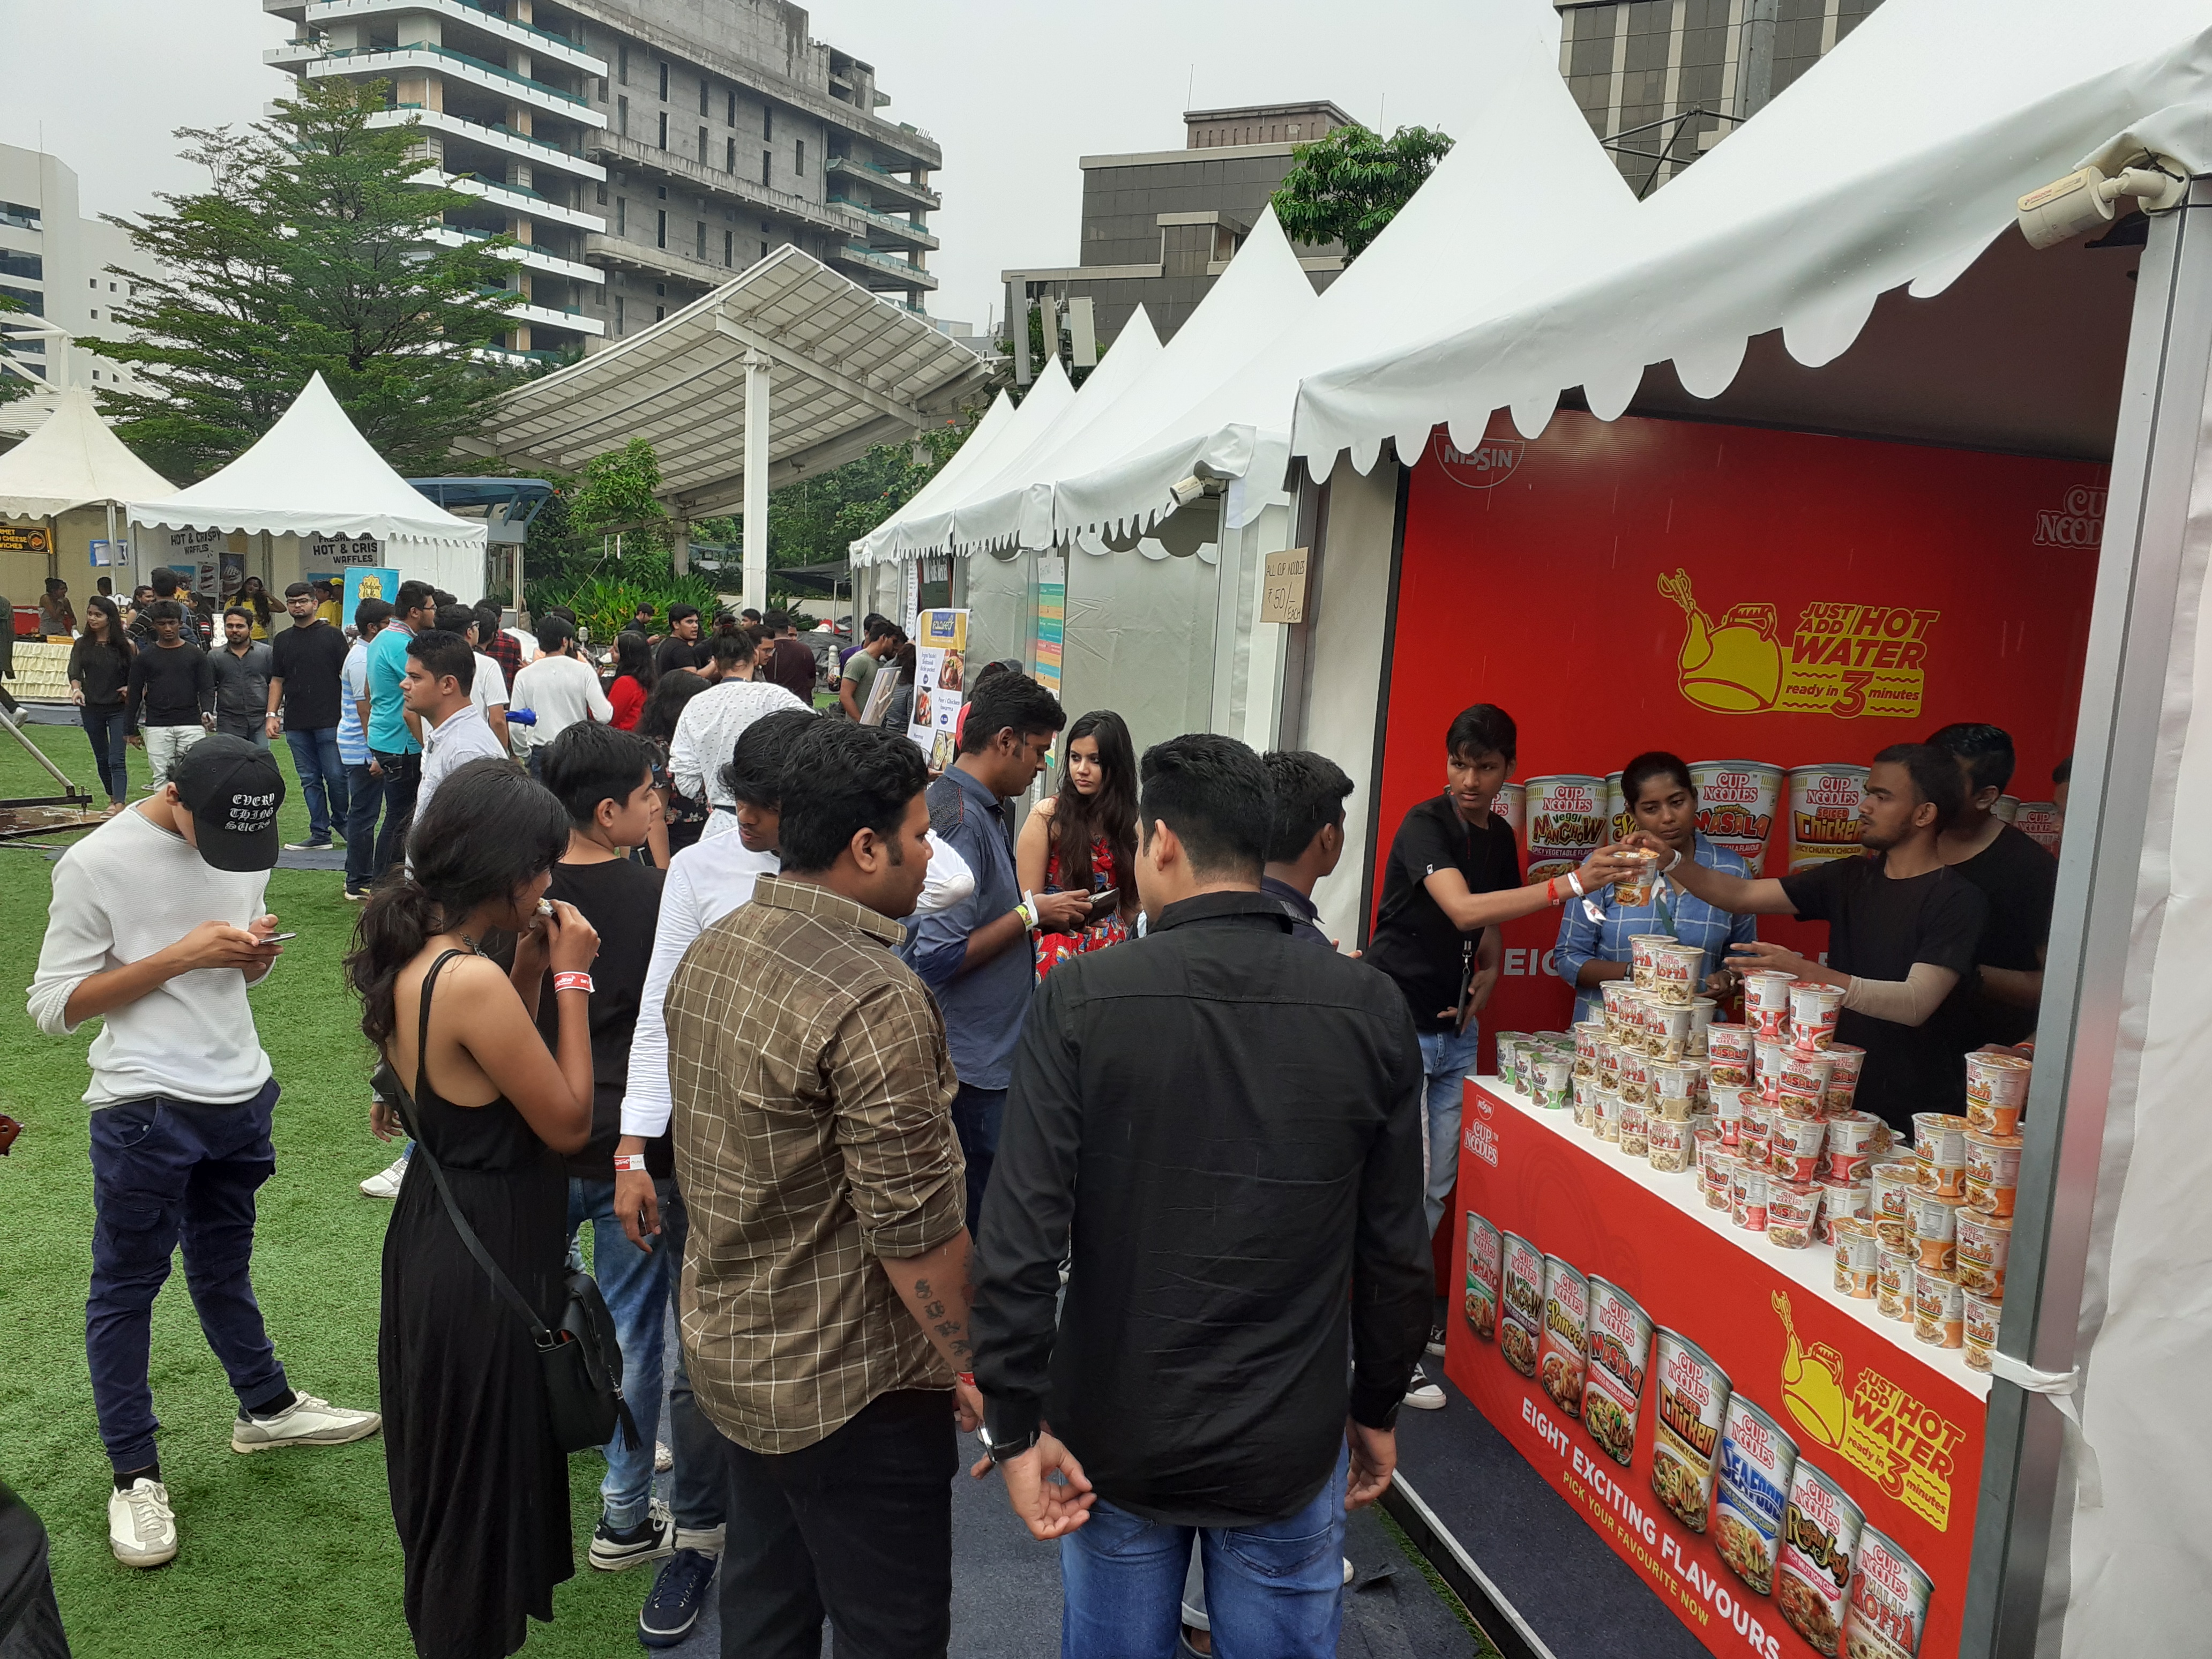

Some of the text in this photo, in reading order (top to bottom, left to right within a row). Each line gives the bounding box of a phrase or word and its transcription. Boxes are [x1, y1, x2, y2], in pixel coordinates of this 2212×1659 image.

[171, 530, 221, 545] HOT & CRISPY
[184, 544, 209, 555] WAFFLES
[313, 544, 335, 556] HOT
[340, 543, 348, 554] &
[333, 555, 373, 563] WAFFLES
[1266, 565, 1275, 577] ALL
[1287, 606, 1301, 621] EACH
[1796, 618, 1844, 634] ADD
[1801, 603, 1939, 640] JUST HOT
[1791, 634, 1926, 670] WATER
[1785, 670, 1920, 718] ready in 3 minutes
[1555, 786, 1585, 799] CUP
[1703, 786, 1758, 802] NOODLES
[1717, 773, 1750, 788] CUP
[1819, 776, 1851, 792] CUP
[233, 793, 274, 807] EVERY
[1543, 798, 1593, 812] NOODLES
[1806, 790, 1859, 805] NOODLES
[225, 819, 271, 832] SUCKS
[229, 807, 274, 821] THING
[1694, 809, 1771, 840] MASALA
[1817, 807, 1849, 819] SPICED
[2027, 812, 2049, 823] CUP
[1532, 846, 1577, 856] SPICY VEGETABLE
[1809, 846, 1836, 854] CHUNKY
[1780, 1071, 1821, 1091] MASALA
[1474, 1120, 1493, 1143] CUP
[1465, 1130, 1497, 1165] NOODLES
[1769, 1202, 1811, 1222] MASALA
[1474, 1232, 1496, 1259] NOODLES
[1479, 1226, 1492, 1243] CUP
[1468, 1251, 1499, 1292] TOMATO
[1511, 1254, 1538, 1286] NOODLES
[1518, 1248, 1534, 1268] CUP
[1554, 1281, 1583, 1316] NOODLES
[1561, 1273, 1579, 1296] CUP
[1609, 1297, 1630, 1325] CUP
[1546, 1298, 1588, 1355] Paneer
[1600, 1305, 1635, 1347] NOODLES
[1589, 1332, 1643, 1399] MASALA
[1678, 1352, 1703, 1381] CUP
[1669, 1359, 1709, 1406] NOODLES
[1856, 1381, 1890, 1409] ADD
[1676, 1387, 1701, 1417] SPICED
[1859, 1369, 1966, 1454] JUST HOT
[1660, 1379, 1717, 1461] Chicken
[1743, 1415, 1768, 1444] CUP
[1732, 1421, 1774, 1470] NOODLES
[1852, 1391, 1954, 1483] WATER
[1668, 1431, 1690, 1458] CHUNKY
[1689, 1452, 1710, 1473] CHICKEN
[1720, 1436, 1785, 1523] SEAFOOD
[1848, 1436, 1947, 1515] ready in 3 minutes
[1732, 1494, 1758, 1523] SEAFOOD
[1806, 1479, 1834, 1509] CUP
[1796, 1485, 1840, 1535] NOODLES
[1522, 1396, 1780, 1659] EIGHT EXCITING FLAVOURS
[1563, 1470, 1709, 1627] PICK YOUR FAVOURITE NOW
[1786, 1501, 1850, 1589] Rogan Josh
[1873, 1544, 1901, 1575] CUP
[1798, 1558, 1824, 1587] MUTTON
[1862, 1549, 1908, 1602] NOODLES
[1866, 1574, 1904, 1619] MALAI
[1850, 1570, 1914, 1657] KOFTA
[1872, 1628, 1892, 1652] KOFTA
